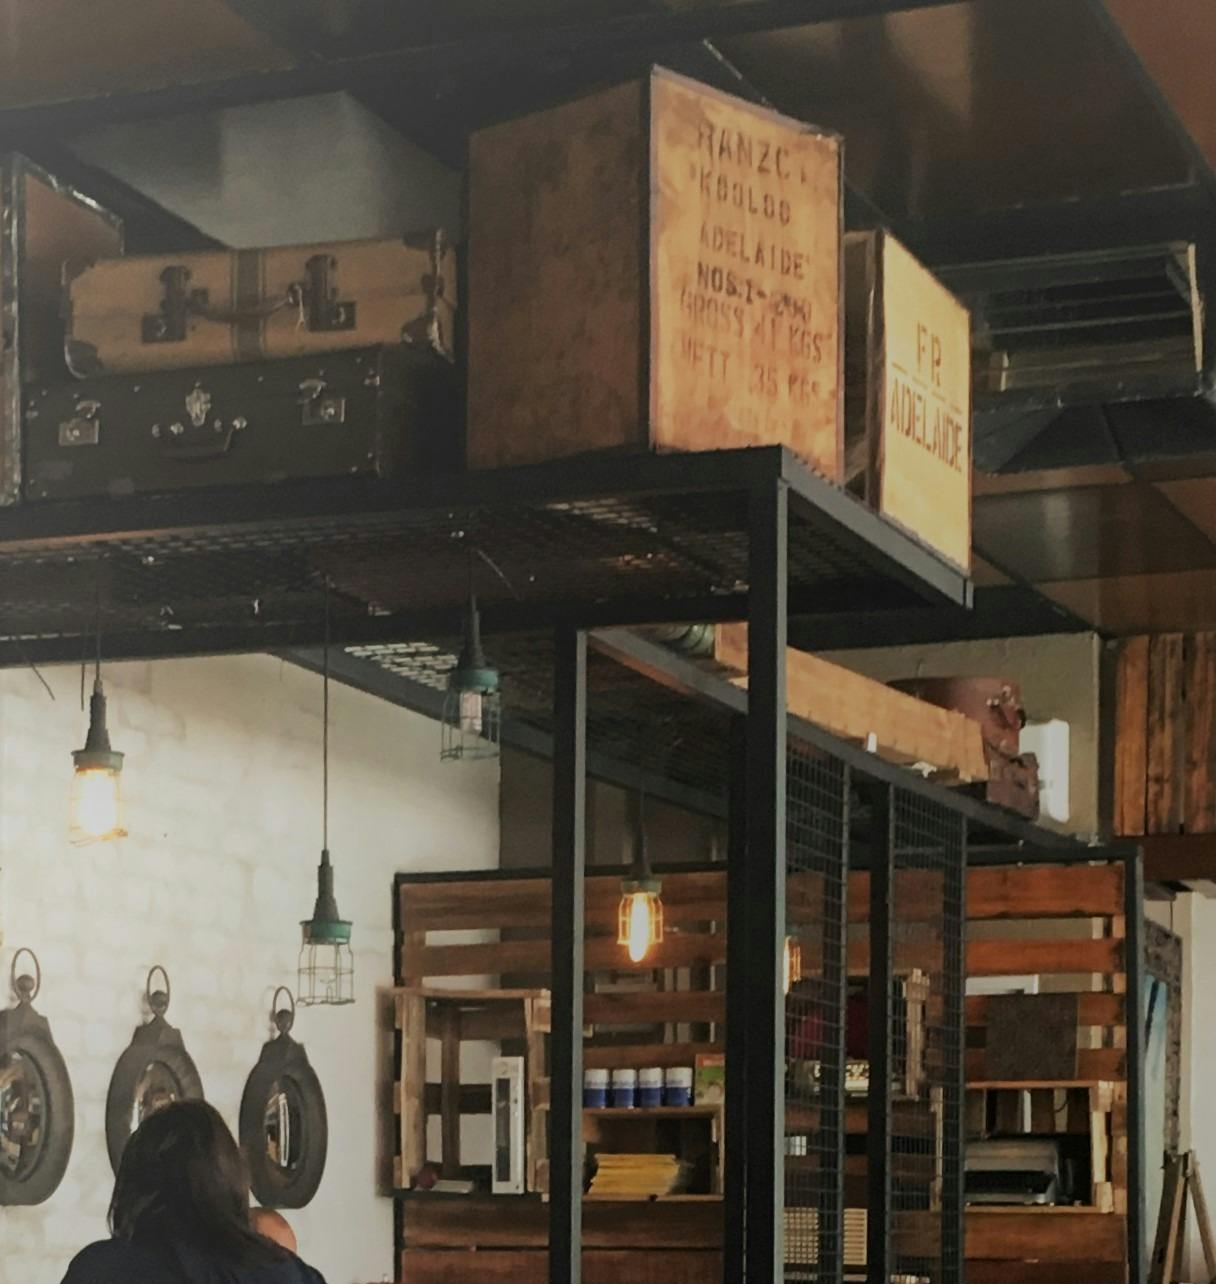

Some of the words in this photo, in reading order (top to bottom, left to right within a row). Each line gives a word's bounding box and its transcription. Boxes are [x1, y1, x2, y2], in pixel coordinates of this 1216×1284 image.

[700, 221, 805, 280] ADELAIDE
[916, 321, 942, 388] FR
[890, 377, 963, 473] ADELAIDE
